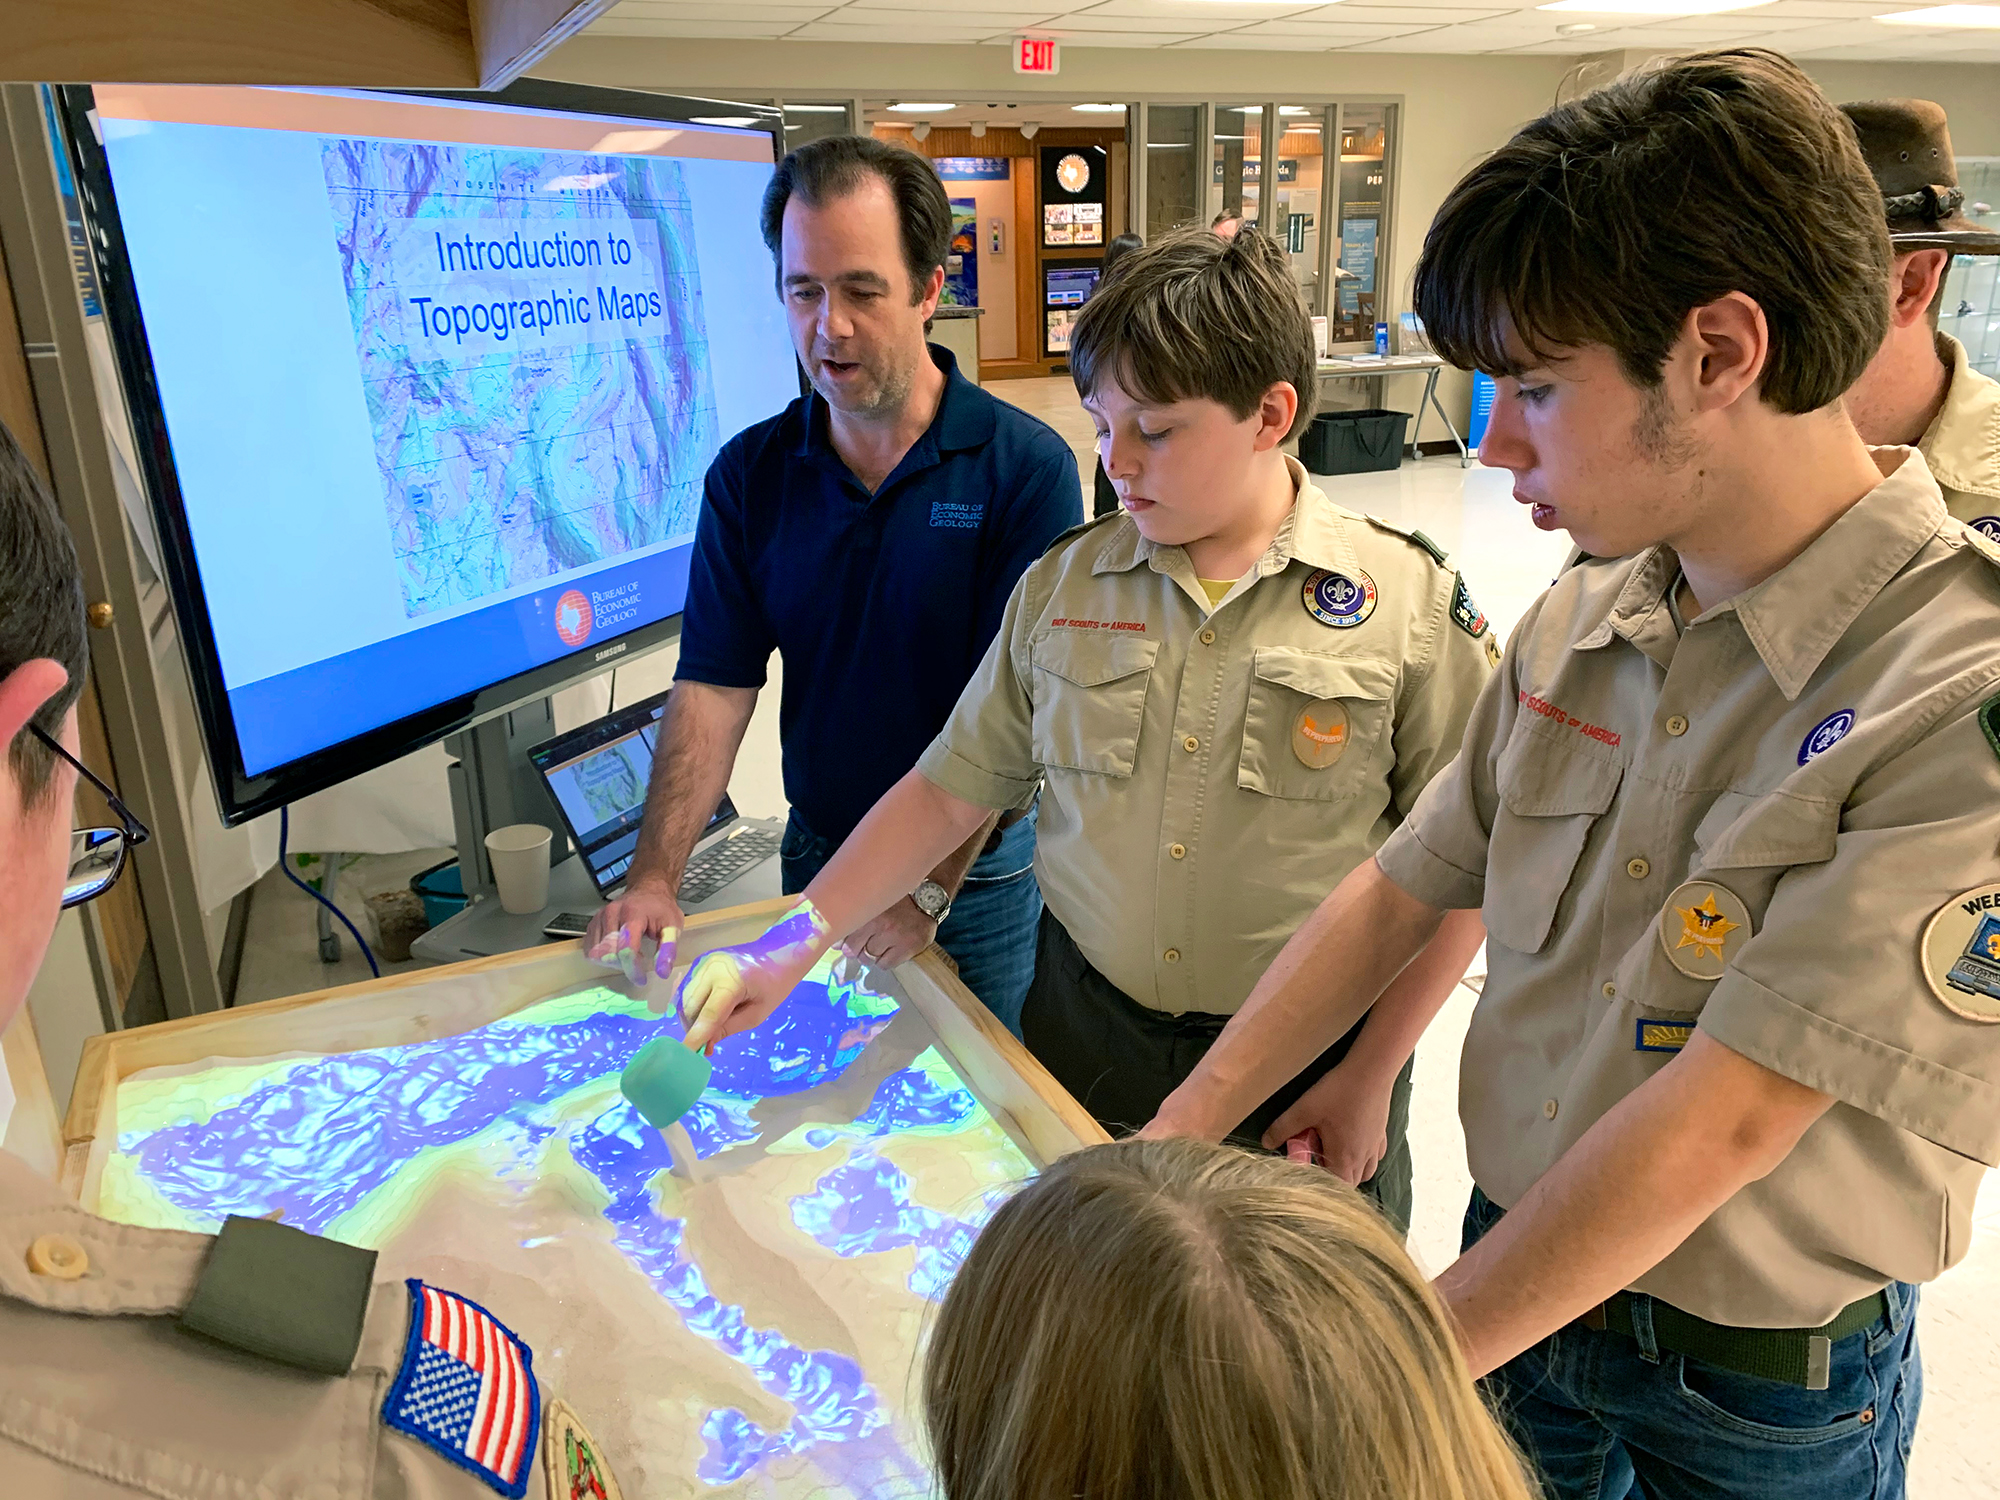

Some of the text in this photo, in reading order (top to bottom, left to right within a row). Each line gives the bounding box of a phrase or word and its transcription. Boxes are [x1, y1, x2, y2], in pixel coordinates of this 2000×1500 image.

[1021, 39, 1055, 71] EXIT
[453, 178, 535, 194] YOSEMITE
[435, 231, 632, 272] Introduction to
[409, 288, 591, 345] Topographic
[596, 284, 662, 327] Maps
[931, 509, 983, 519] ECONOMIC
[932, 502, 969, 511] BUREAU
[929, 517, 980, 528] GEOLOGY
[592, 581, 639, 604] BUREAU OF
[594, 593, 641, 616] ECONOMIC
[596, 607, 637, 628] GEOLOGY
[1051, 619, 1067, 627] BOY
[1068, 619, 1100, 629] SCOUTS
[1110, 621, 1146, 633] AMERICA
[595, 643, 626, 661] SAMSUNG
[1526, 696, 1568, 724] SCOUTS
[1580, 723, 1622, 748] AMERICA
